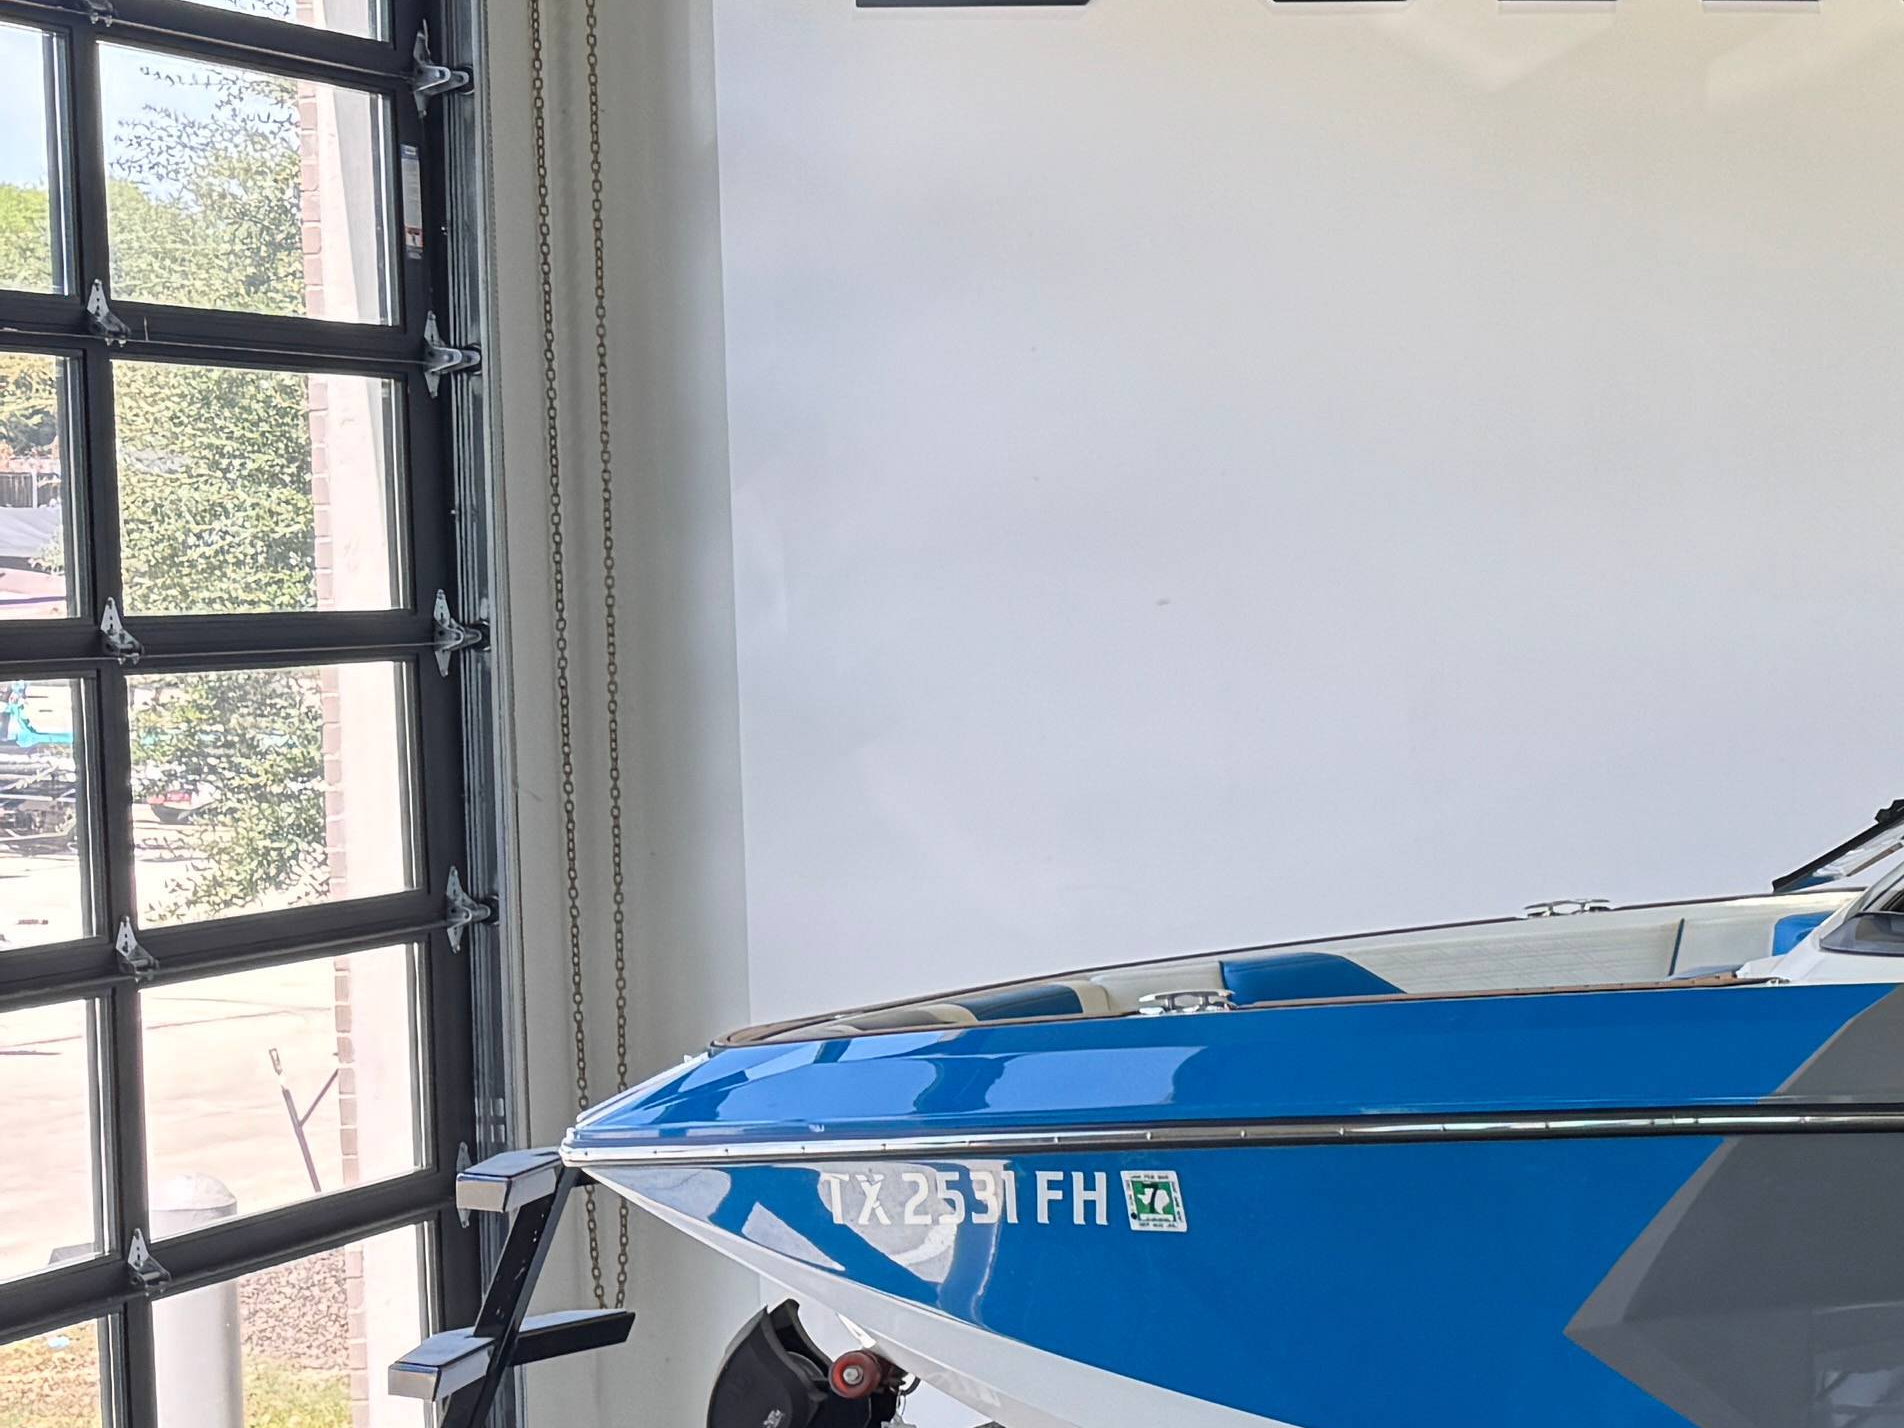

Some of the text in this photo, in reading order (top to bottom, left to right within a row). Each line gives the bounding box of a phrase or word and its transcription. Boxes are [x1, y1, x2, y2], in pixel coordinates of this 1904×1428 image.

[819, 1170, 1108, 1225] TX 2531 FH
